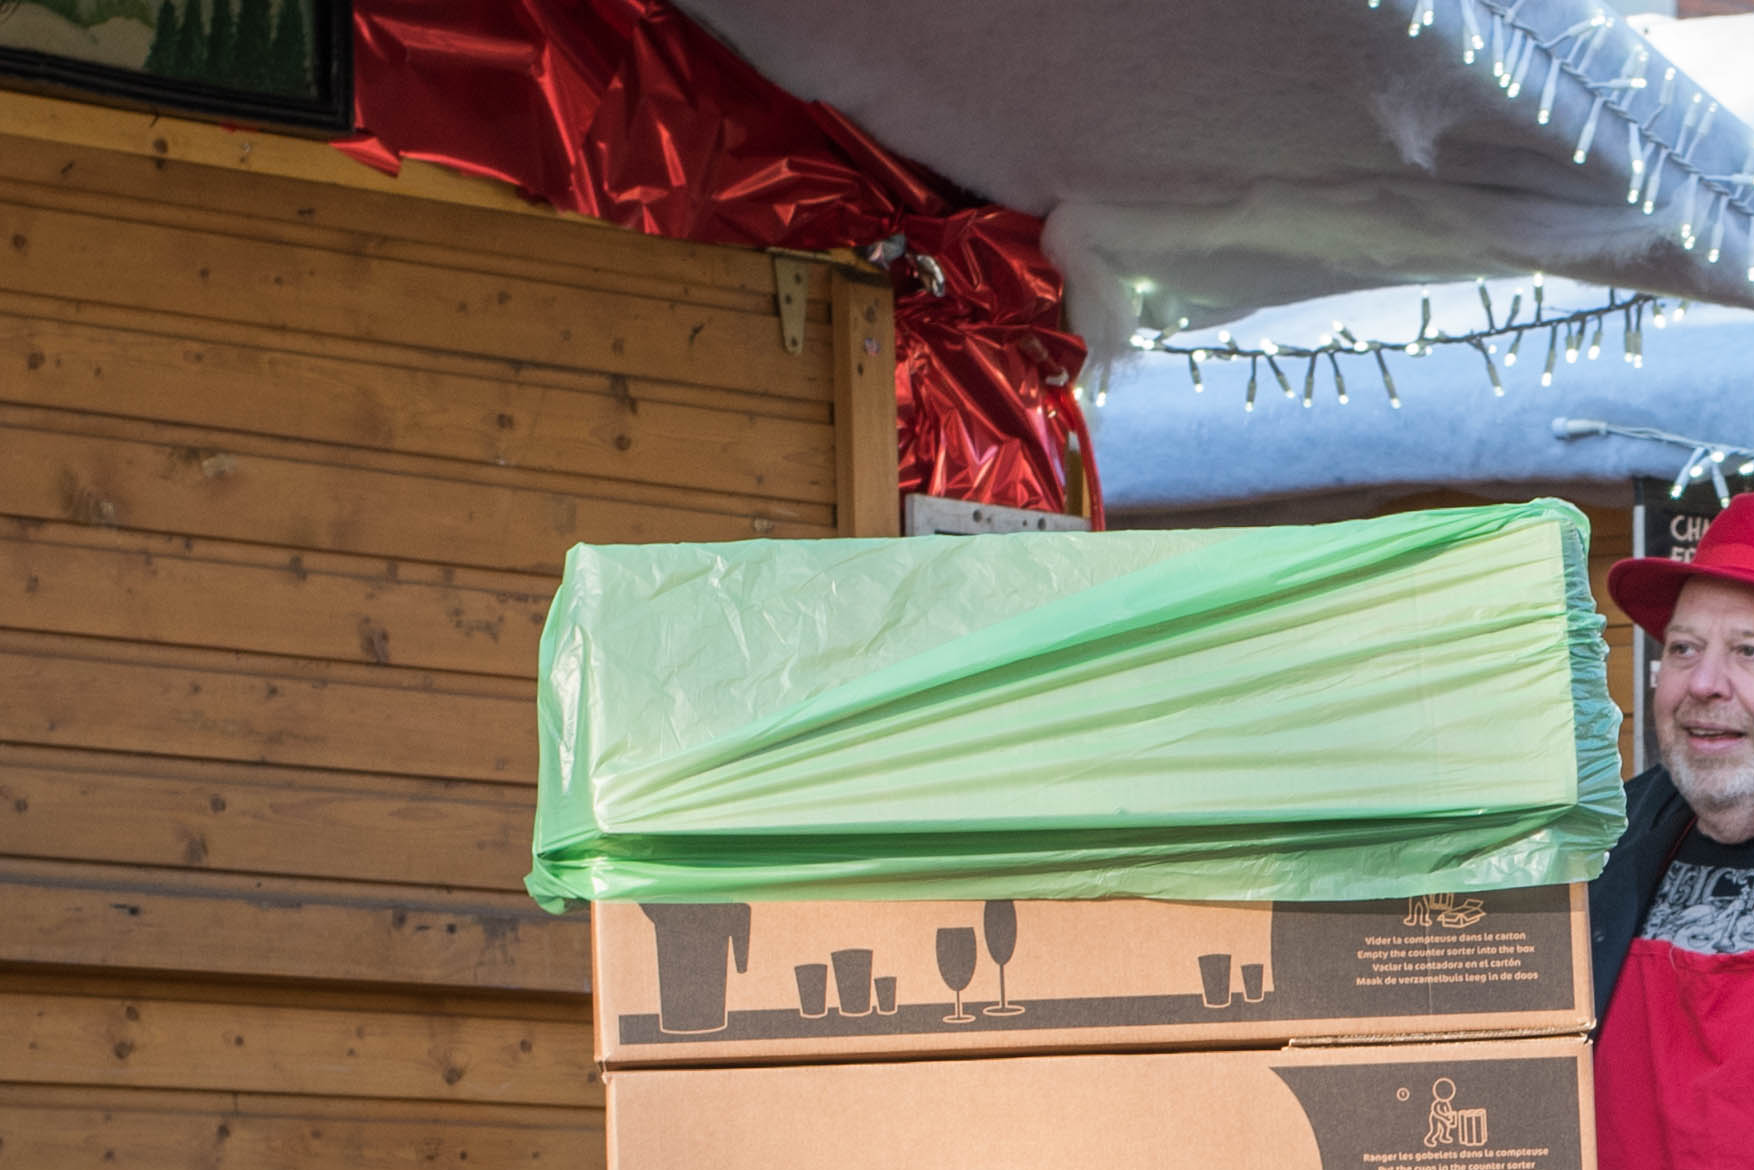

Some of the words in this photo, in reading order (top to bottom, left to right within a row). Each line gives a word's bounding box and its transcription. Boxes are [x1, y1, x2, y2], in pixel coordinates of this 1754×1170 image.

[1365, 936, 1392, 945] Vider
[1393, 936, 1402, 944] la
[1404, 935, 1457, 945] compteuse
[1459, 933, 1482, 942] dans
[1484, 932, 1493, 941] le
[1495, 932, 1526, 940] carton
[1357, 950, 1388, 960] Empty
[1390, 949, 1406, 958] the
[1408, 949, 1445, 957] counter
[1446, 947, 1475, 956] sorter
[1476, 946, 1497, 955] into
[1499, 945, 1515, 954] the
[1517, 945, 1535, 953] box
[1403, 962, 1413, 971] la
[1415, 961, 1463, 970] contadora
[1478, 960, 1488, 968] el
[1490, 957, 1521, 968] cartón
[1384, 976, 1397, 984] de
[1398, 974, 1463, 984] verzamelbuis
[1465, 973, 1487, 983] leeg
[1488, 972, 1498, 981] in
[1500, 972, 1512, 980] de
[1514, 972, 1539, 980] doos
[1363, 1153, 1397, 1163] Ranger
[1398, 1152, 1414, 1161] les
[1415, 1151, 1458, 1162] gobelets
[1459, 1150, 1484, 1158] dans
[1484, 1149, 1494, 1158] la
[1495, 1149, 1549, 1159] compteuse
[1468, 1163, 1506, 1170] counter
[1507, 1161, 1536, 1170] sorter
